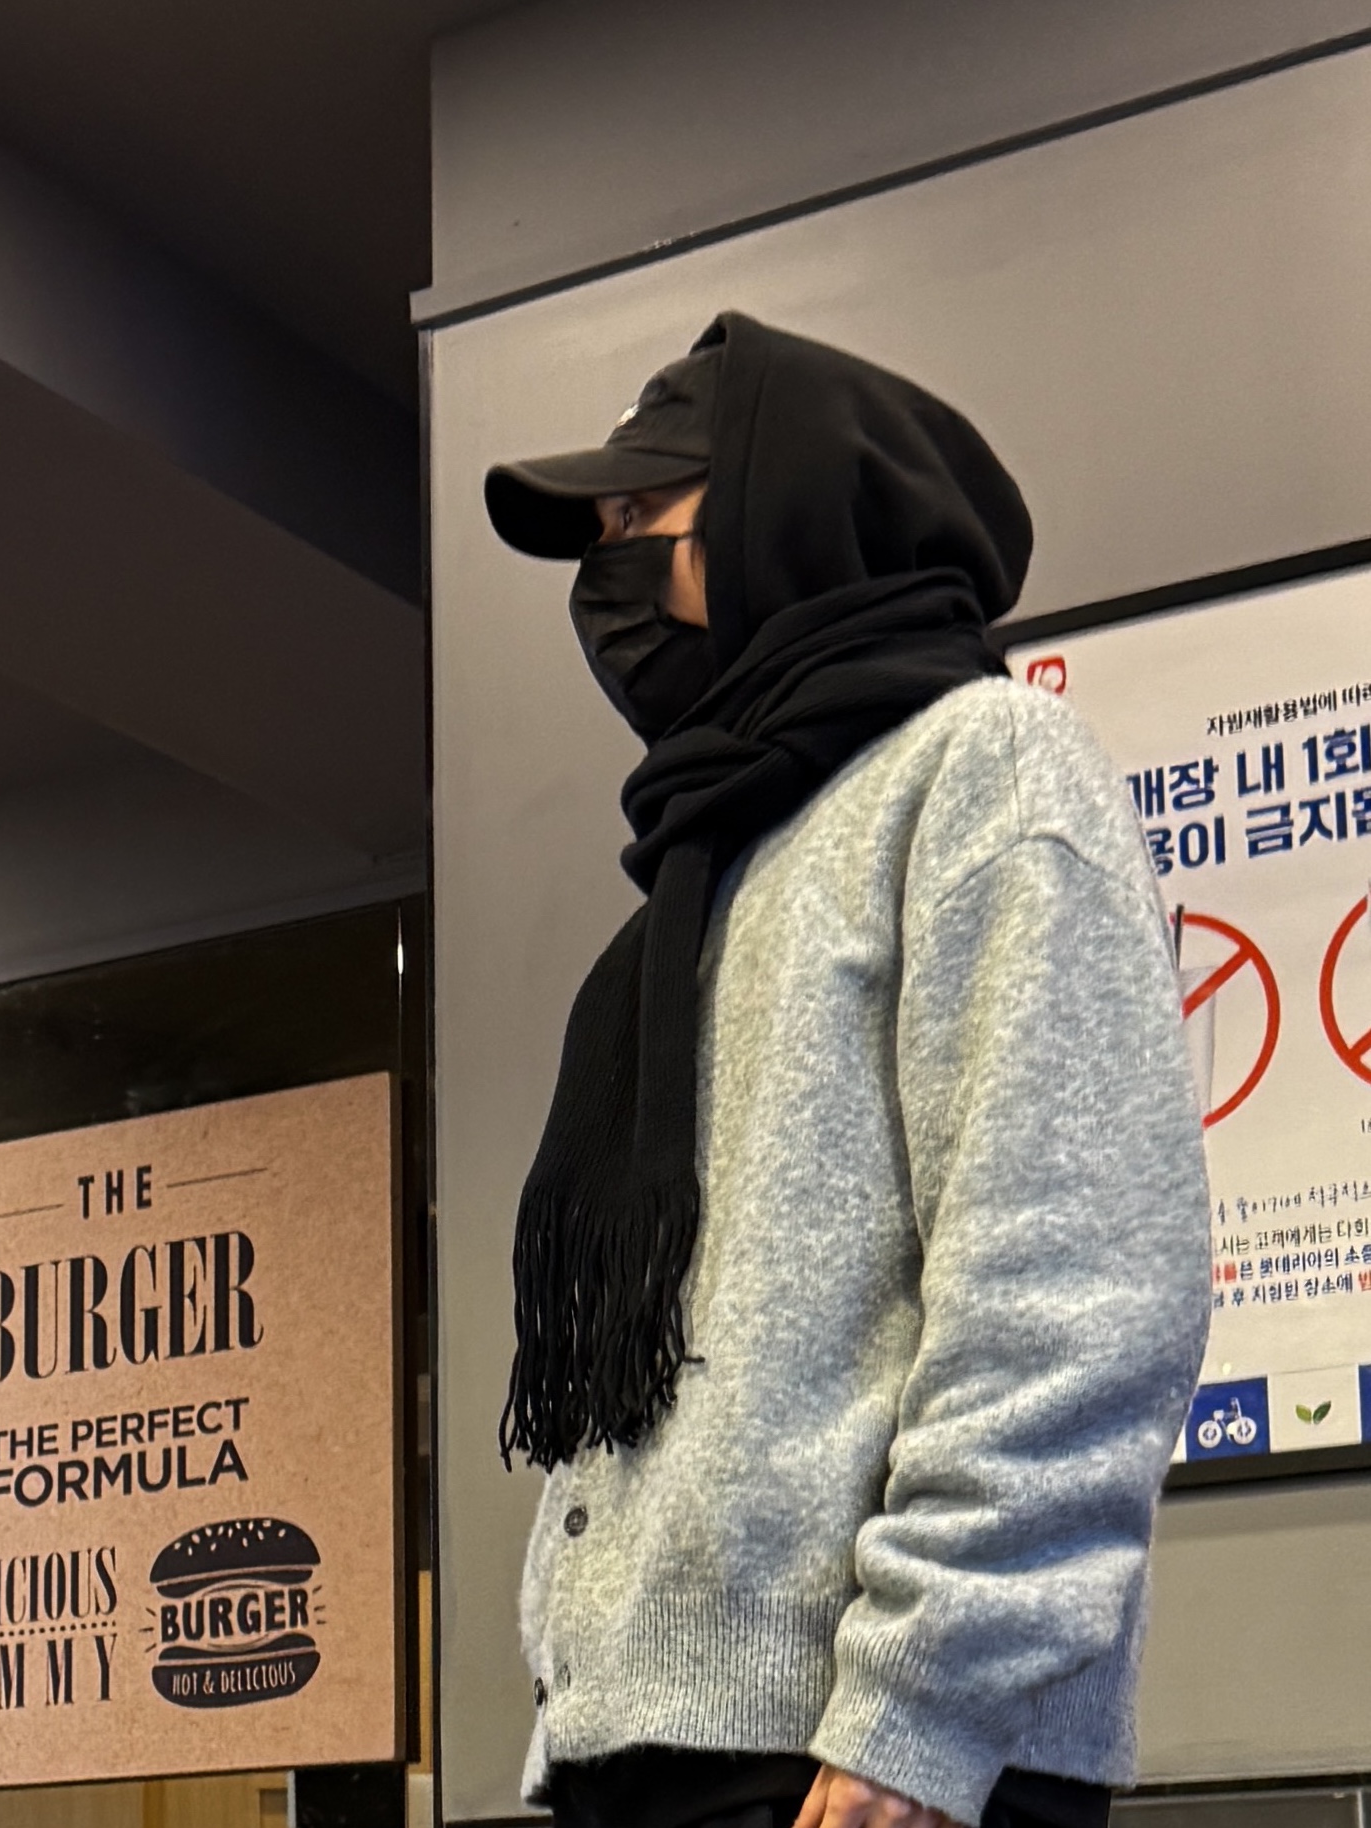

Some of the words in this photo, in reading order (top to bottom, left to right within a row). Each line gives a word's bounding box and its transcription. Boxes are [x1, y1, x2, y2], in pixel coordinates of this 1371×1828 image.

[1236, 742, 1285, 798] 내
[77, 1165, 152, 1219] THE
[71, 1397, 250, 1452] PERFECT
[161, 1588, 309, 1642] BURGER
[172, 1669, 198, 1696] HOT
[202, 1668, 215, 1694] &
[221, 1660, 296, 1694] DELICIOUS
